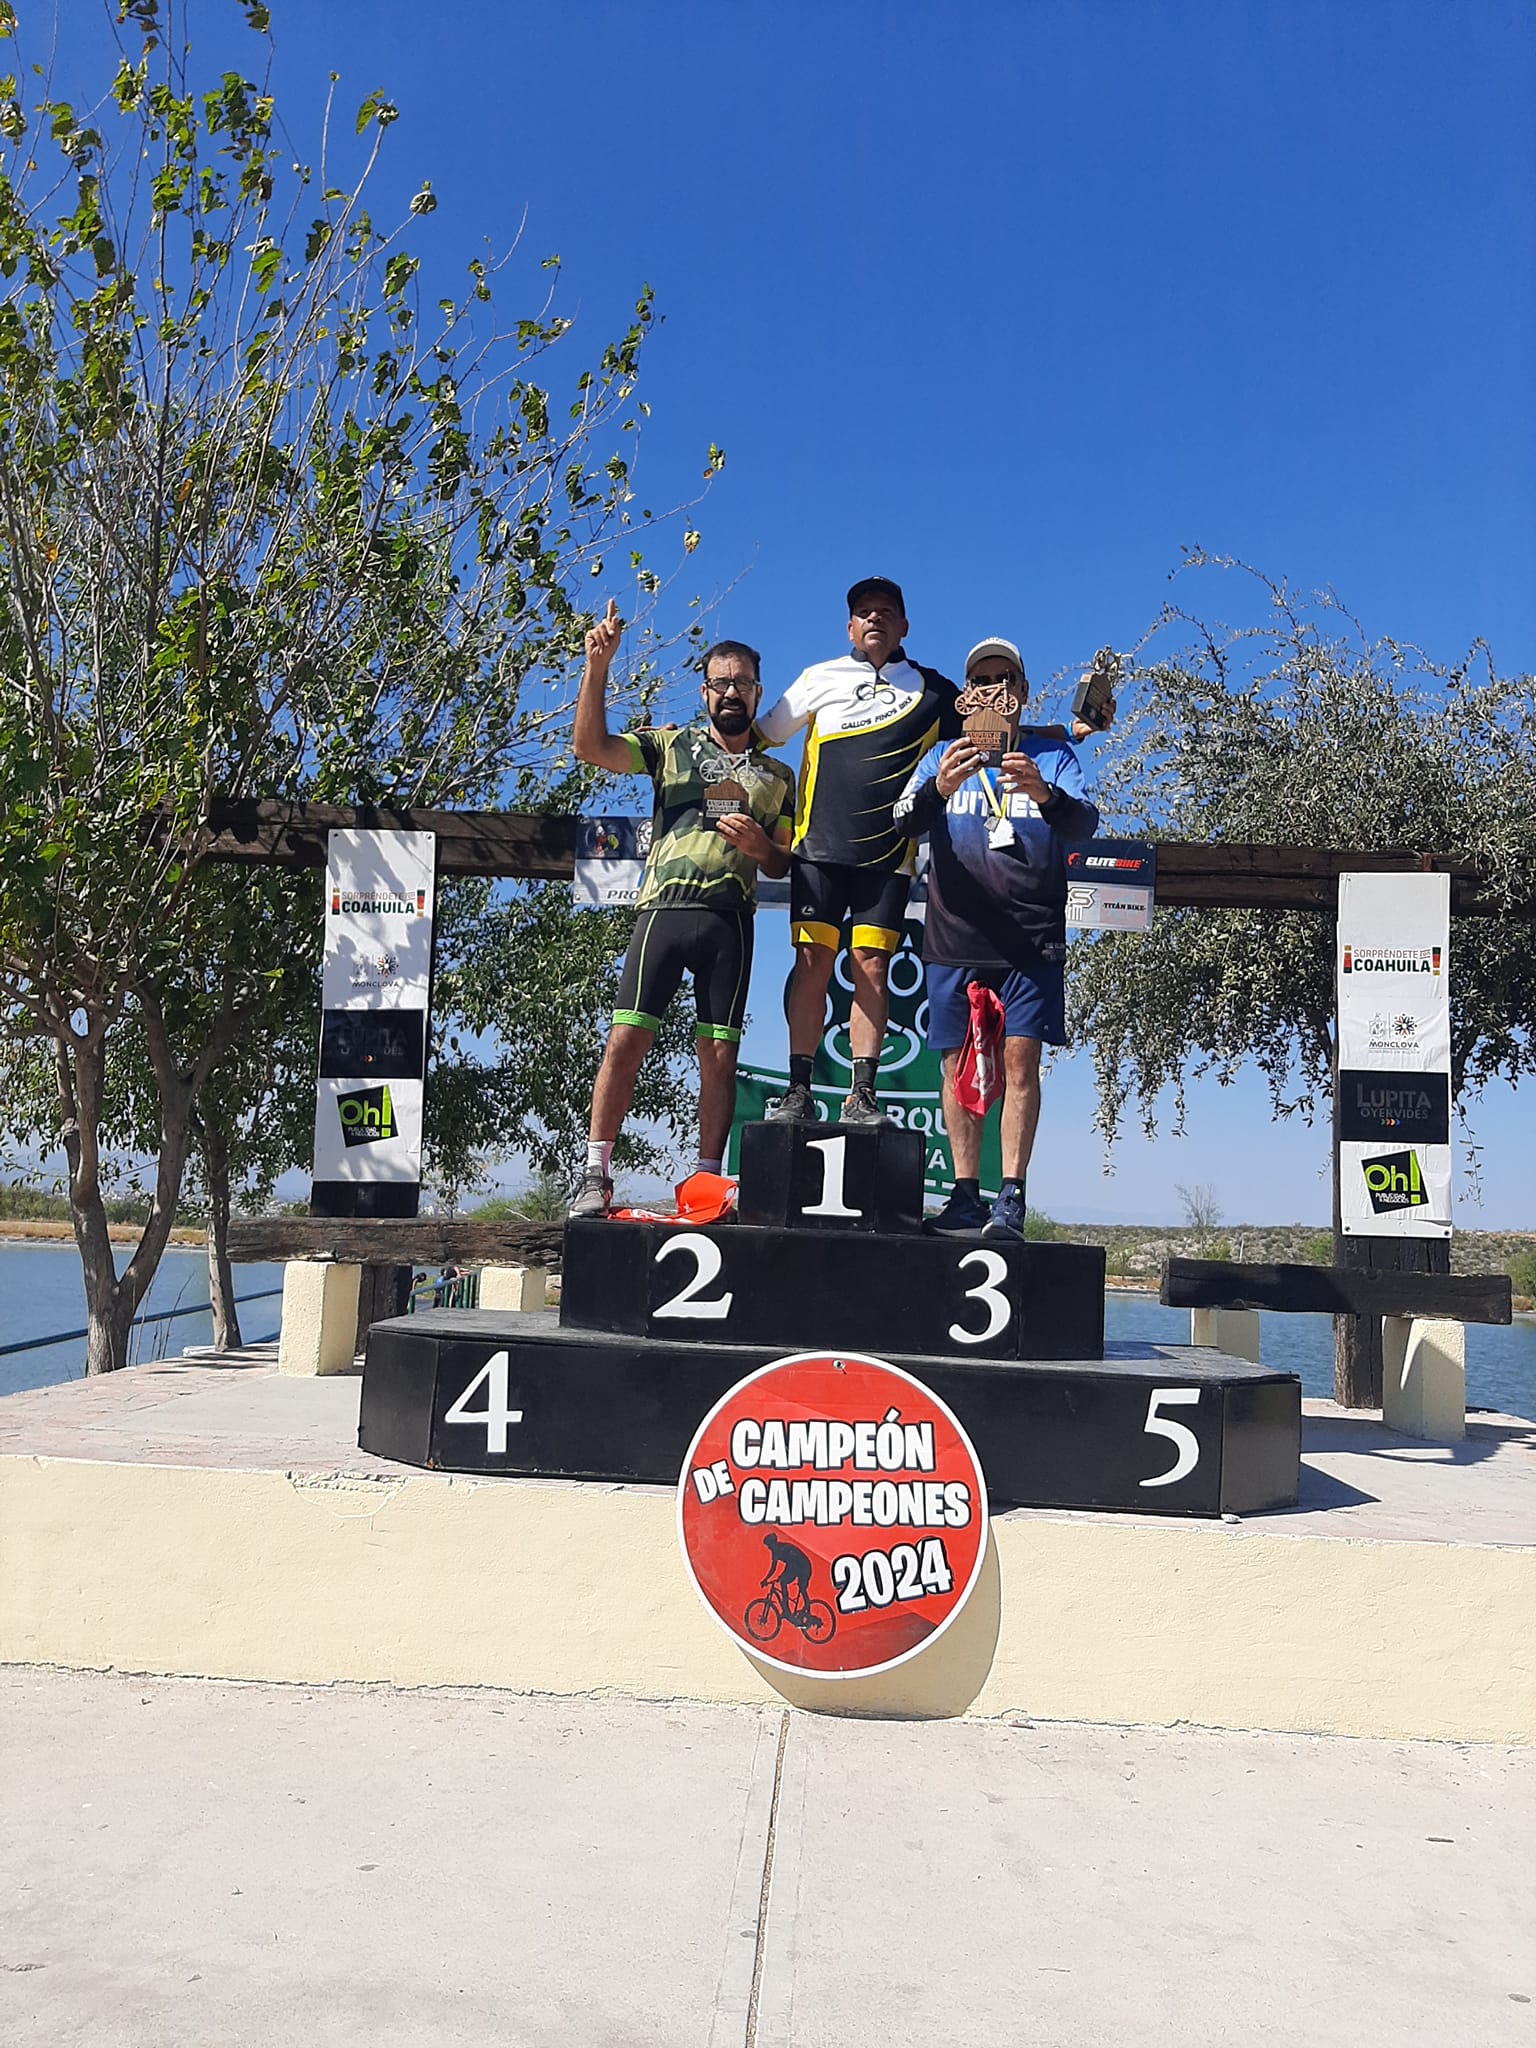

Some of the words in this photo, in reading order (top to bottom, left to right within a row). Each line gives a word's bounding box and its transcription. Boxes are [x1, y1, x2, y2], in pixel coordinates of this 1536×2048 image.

[342, 901, 415, 914] COAHUILA
[1353, 948, 1419, 959] SORPRÉNDETE
[1353, 959, 1432, 973] COAHUILA
[1369, 1041, 1420, 1049] MONCLOVA
[340, 1085, 392, 1138] Oh!
[1360, 1108, 1429, 1120] OYERVIDES
[801, 1135, 864, 1217] 1
[1364, 1150, 1421, 1205] Oh!
[652, 1233, 734, 1319] 2
[948, 1249, 1012, 1344] 3
[444, 1350, 523, 1454] 4
[731, 1407, 937, 1471] CAMPEÓN
[1139, 1388, 1201, 1488] 5
[692, 1460, 735, 1504] DE
[739, 1479, 973, 1528] CAMPEONES
[832, 1538, 953, 1613] 2024
